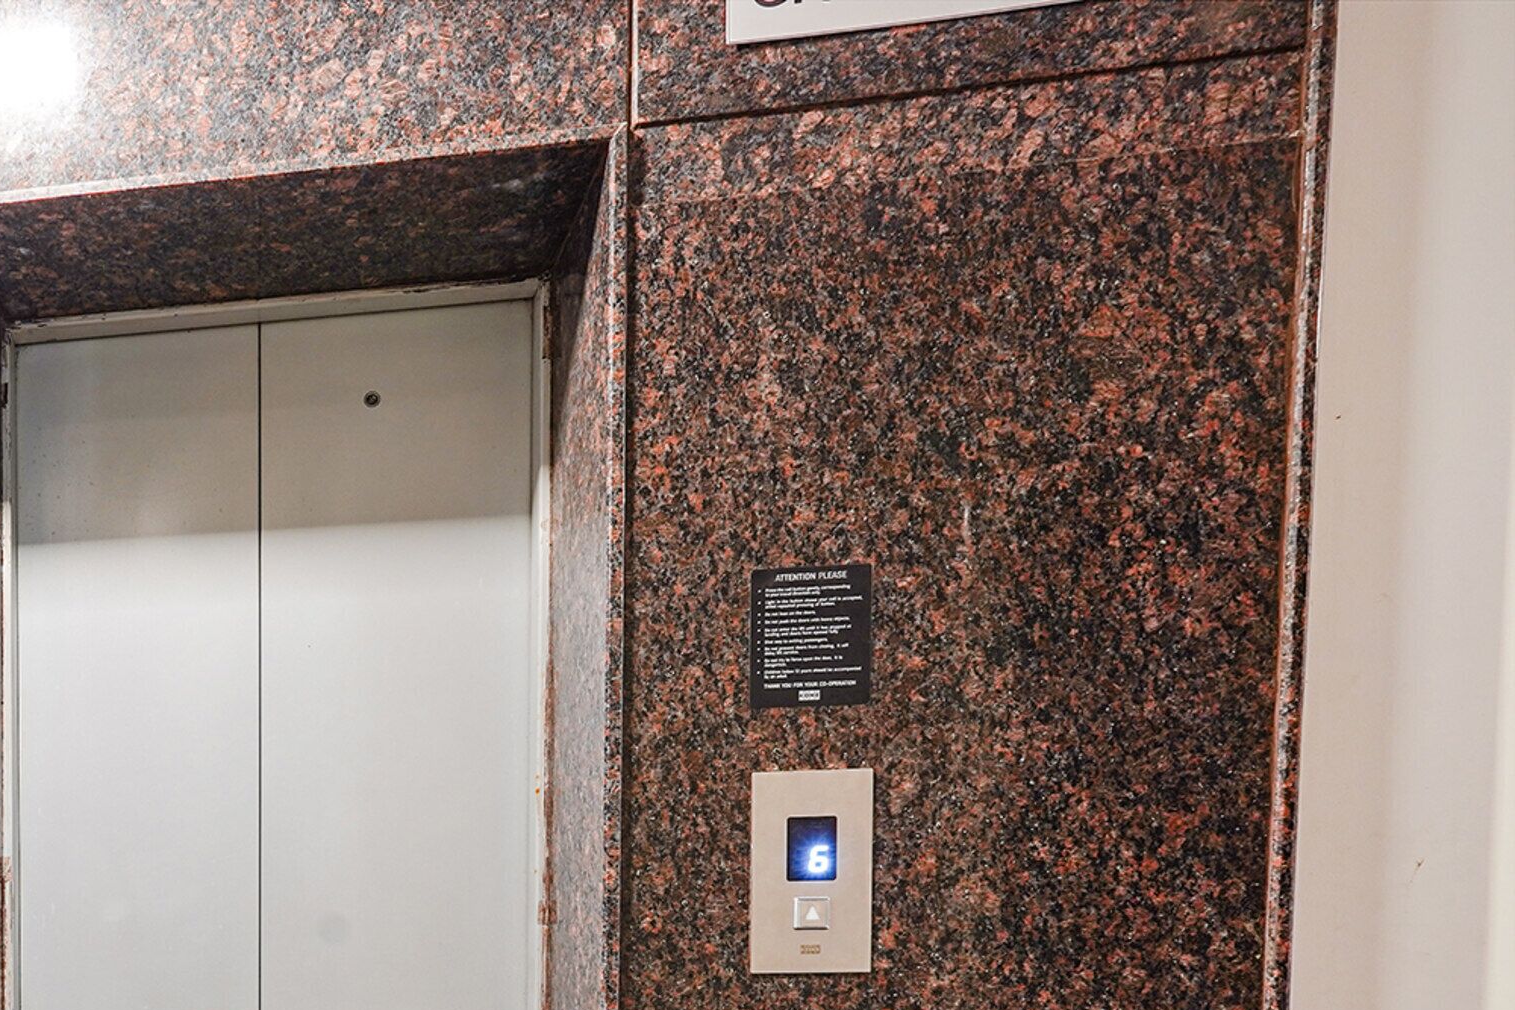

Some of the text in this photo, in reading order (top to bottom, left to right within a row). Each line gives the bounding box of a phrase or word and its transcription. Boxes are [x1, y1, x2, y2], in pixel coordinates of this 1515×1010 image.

[774, 570, 847, 582] ATTENTION PLEASE
[808, 845, 830, 872] 6
